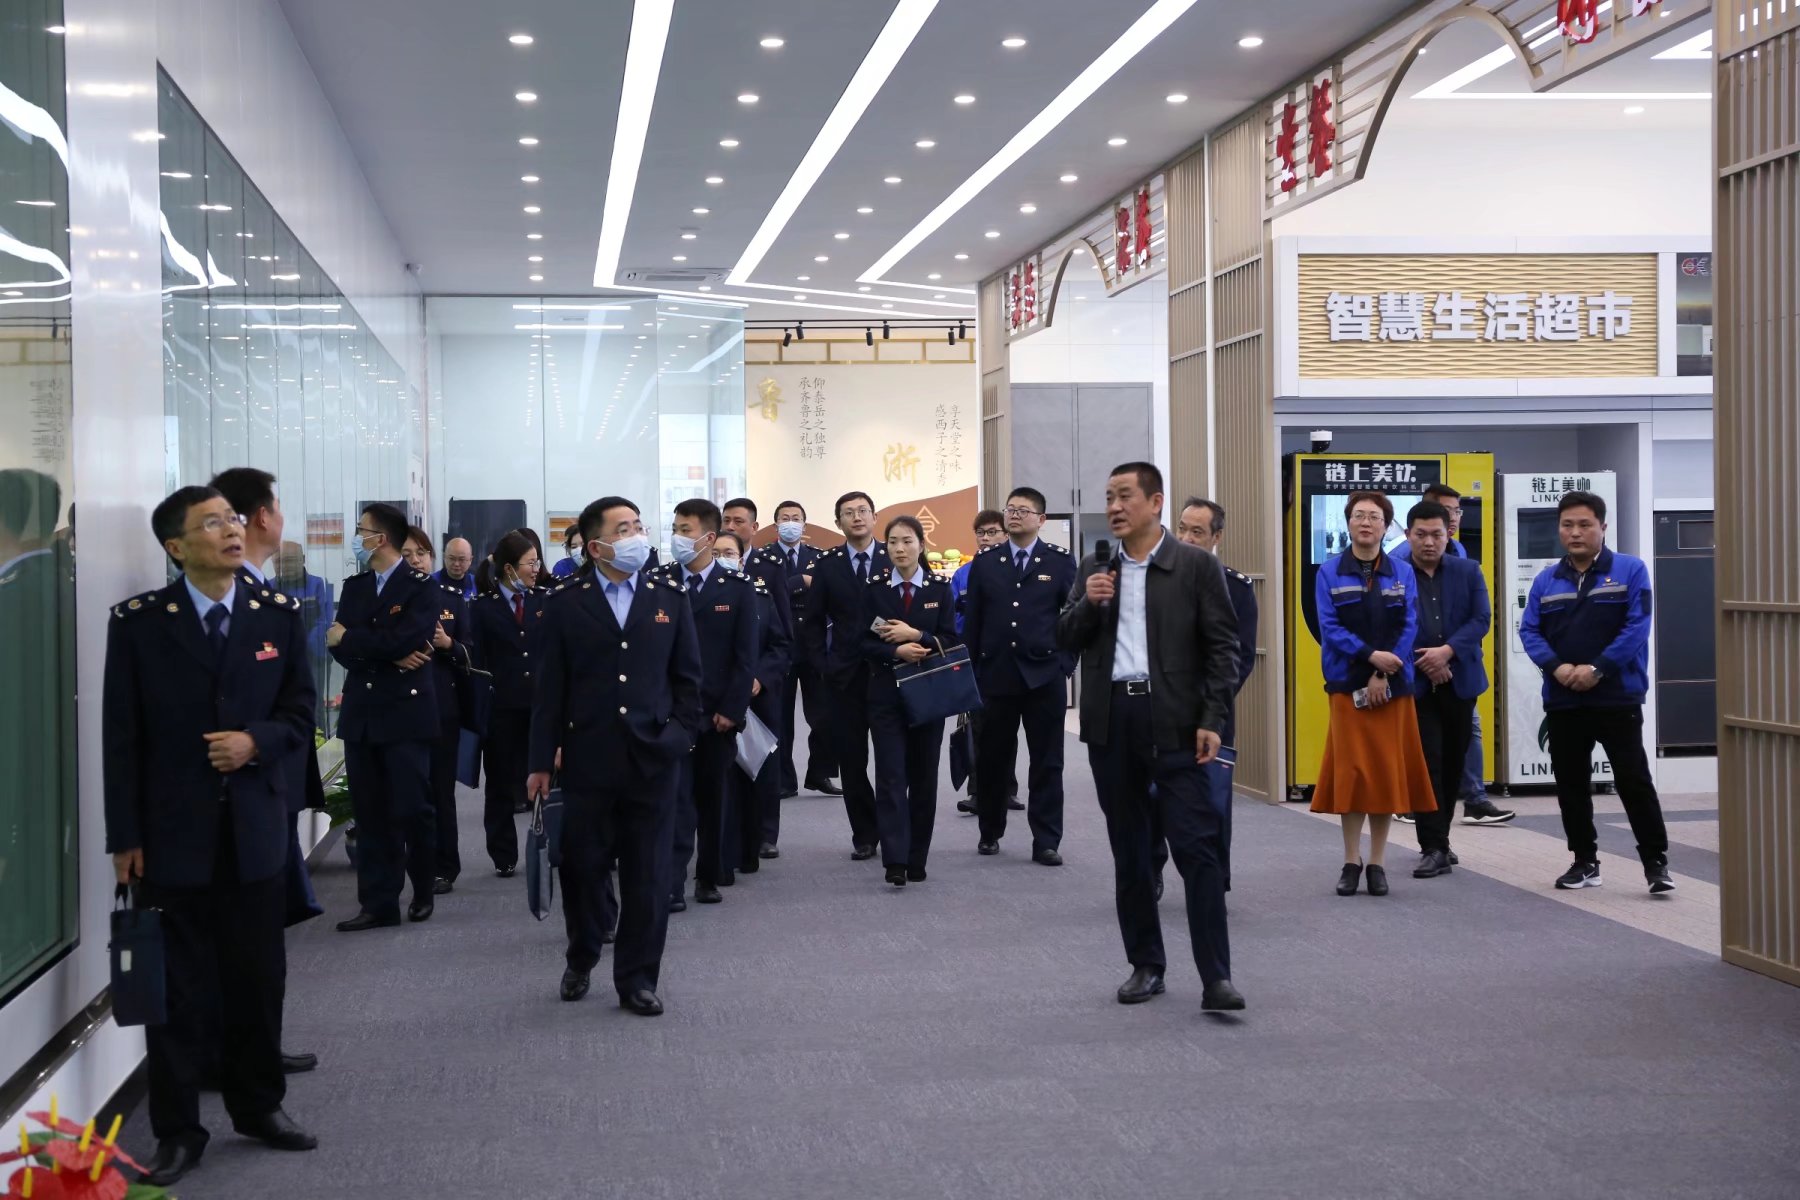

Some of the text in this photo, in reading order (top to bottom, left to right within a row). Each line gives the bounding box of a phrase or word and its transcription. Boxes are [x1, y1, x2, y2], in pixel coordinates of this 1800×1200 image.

[1327, 291, 1633, 341] 智慧生活超市
[799, 376, 813, 459] 承齐鲁之礼韵
[813, 376, 827, 459] 仰泰岳之独尊
[949, 404, 962, 472] 享天堂之味
[883, 442, 921, 487] 浙
[1325, 463, 1417, 483] 链上美饮
[1531, 477, 1591, 493] 链上美咖
